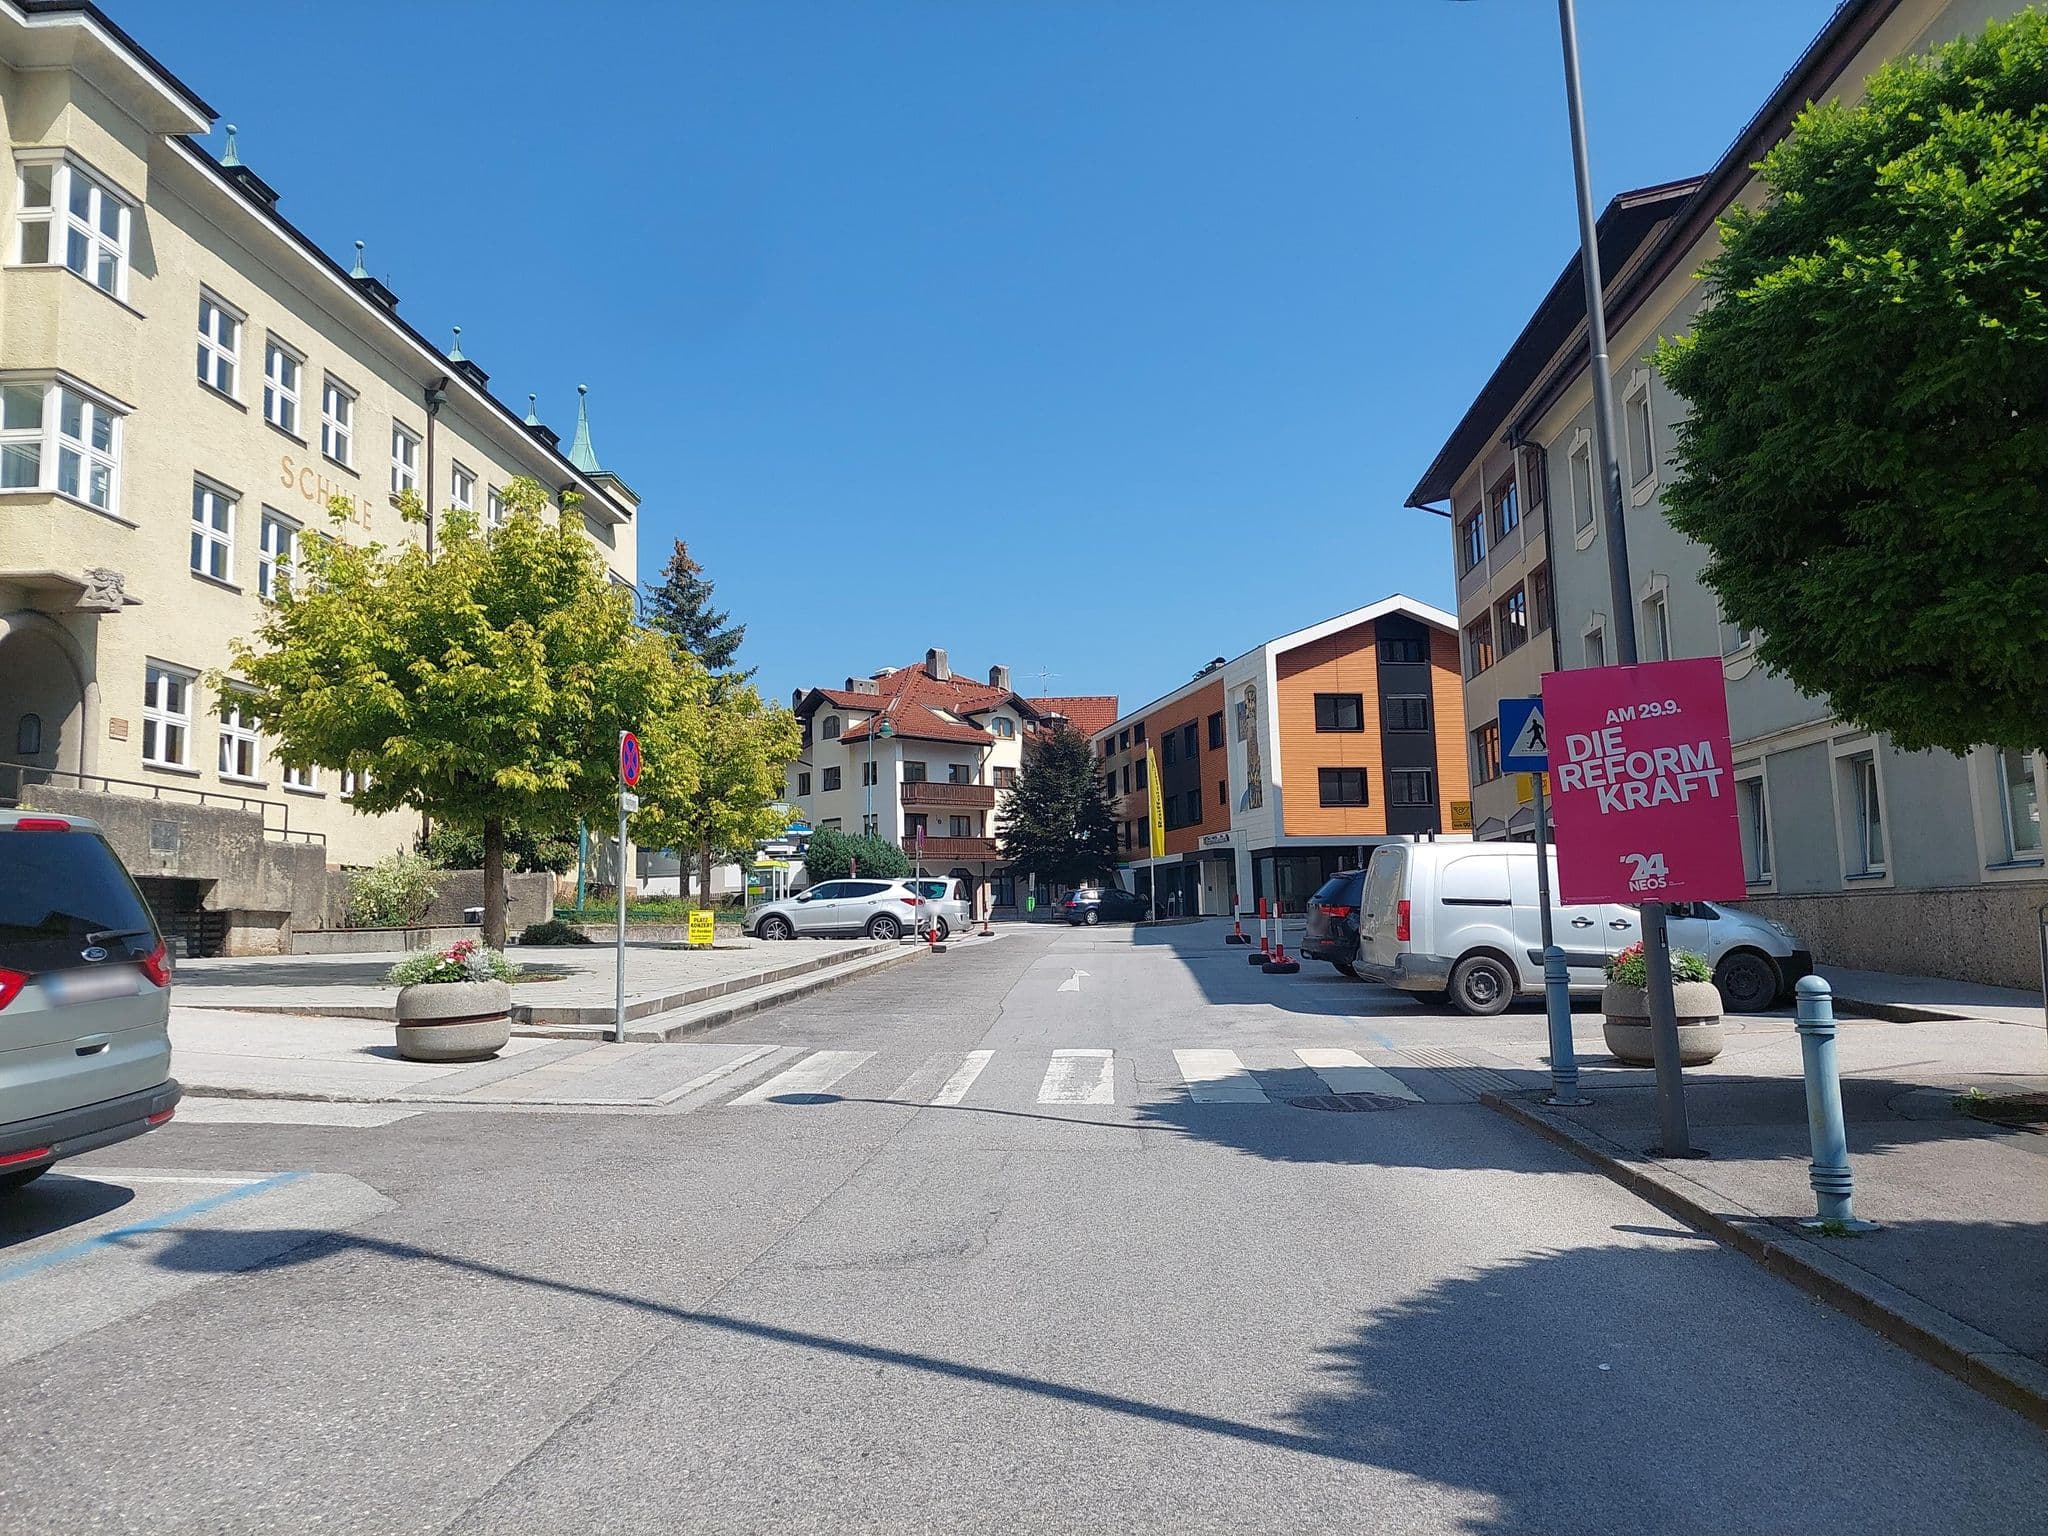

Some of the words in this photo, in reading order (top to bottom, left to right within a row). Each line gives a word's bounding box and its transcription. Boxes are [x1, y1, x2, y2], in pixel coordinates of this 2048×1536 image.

[1606, 706, 1636, 725] AM
[1639, 699, 1682, 719] 29.9.
[1565, 726, 1627, 763] DIE
[1557, 741, 1716, 792] REFORM
[1597, 768, 1724, 815] KRAFT
[1629, 876, 1667, 892] NEOS
